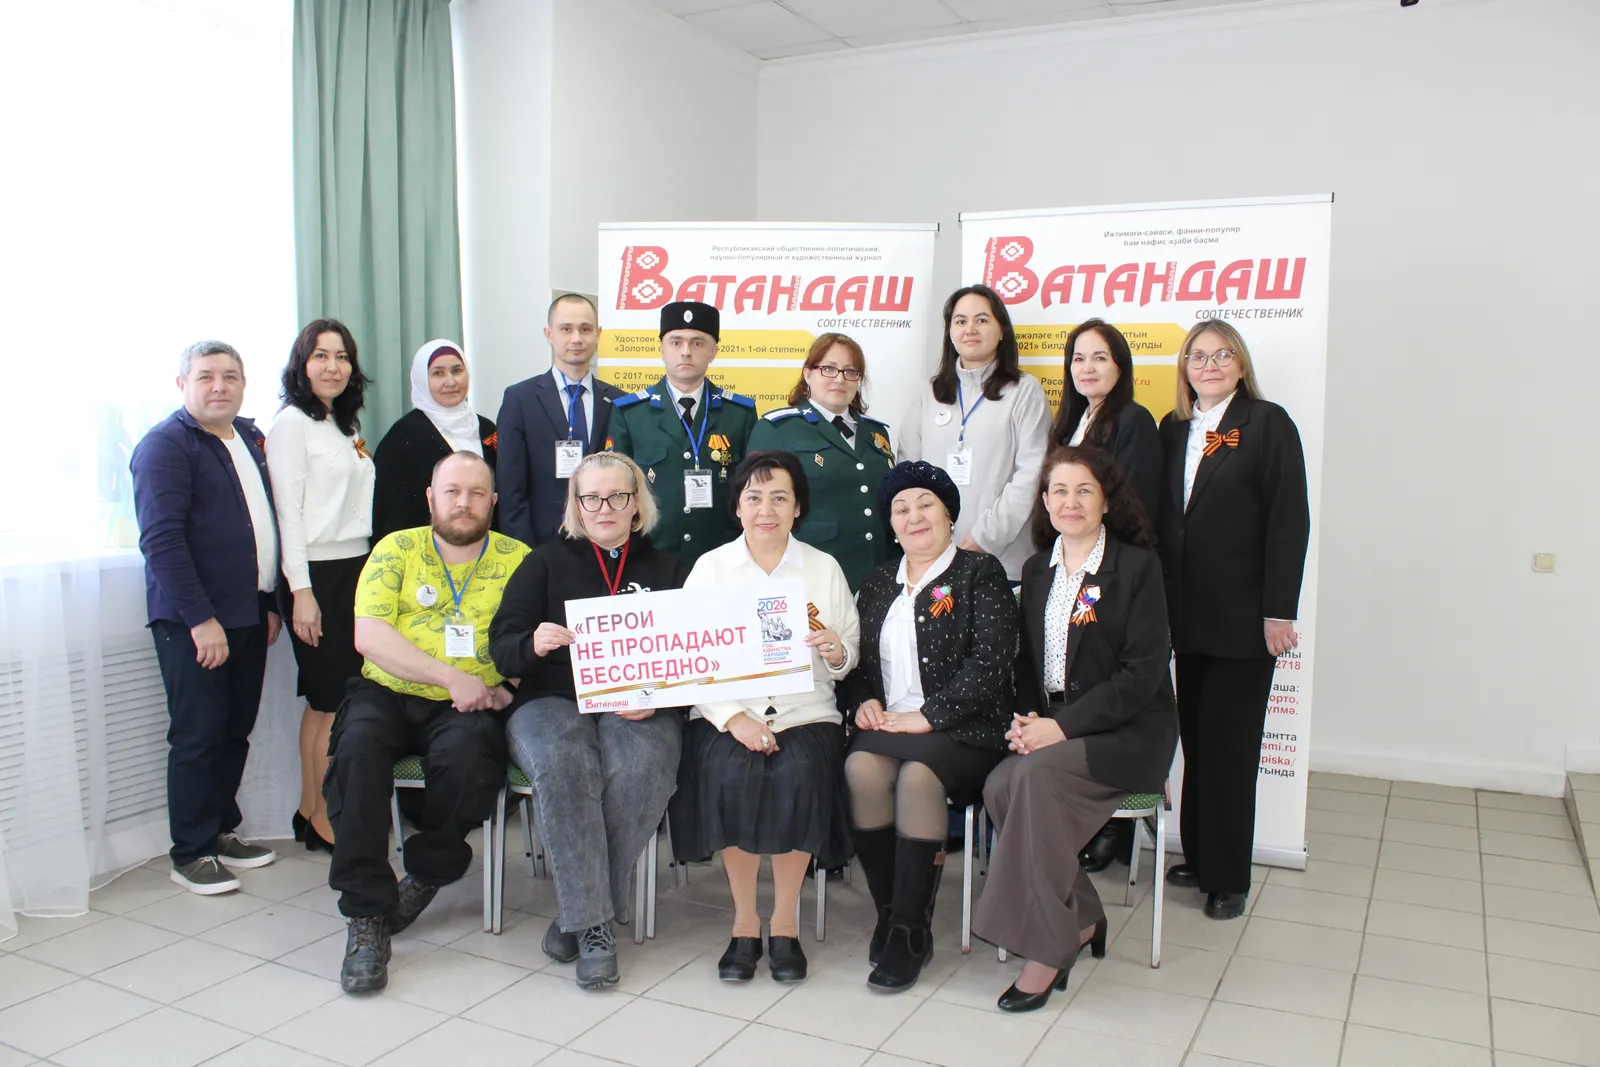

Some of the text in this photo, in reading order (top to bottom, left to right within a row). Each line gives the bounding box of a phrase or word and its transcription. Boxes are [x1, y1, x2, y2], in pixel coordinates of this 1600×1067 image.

[712, 245, 775, 253] Республиканский
[791, 254, 853, 262] художественный
[1195, 308, 1304, 320] СООТЕЧЕСТВЕННИК
[817, 318, 912, 329] СООТЕЧЕСТВЕННИК
[615, 335, 655, 343] Удостоен
[615, 344, 656, 352] «Золотой
[718, 345, 745, 353] -2021»
[1017, 340, 1162, 351] 021» билд булды
[1041, 377, 1063, 385] Рәсә
[1133, 377, 1150, 386] Y.ru
[626, 383, 653, 391] крупн
[759, 394, 790, 402] портал
[759, 599, 787, 612] 2026
[574, 610, 654, 635] «ГЕРОИ
[576, 626, 747, 661] НЕ ПРОПАДАЮТ
[1275, 660, 1300, 670] 2718
[580, 656, 720, 685] БЕССЛЕДНО»
[1273, 683, 1299, 692] аша:
[1269, 694, 1299, 705] орто,
[1266, 706, 1298, 715] үлмә.
[1262, 731, 1297, 741] антта
[1261, 742, 1296, 753] smi.ru
[1261, 755, 1296, 767] piska/
[1258, 766, 1295, 778] тында
